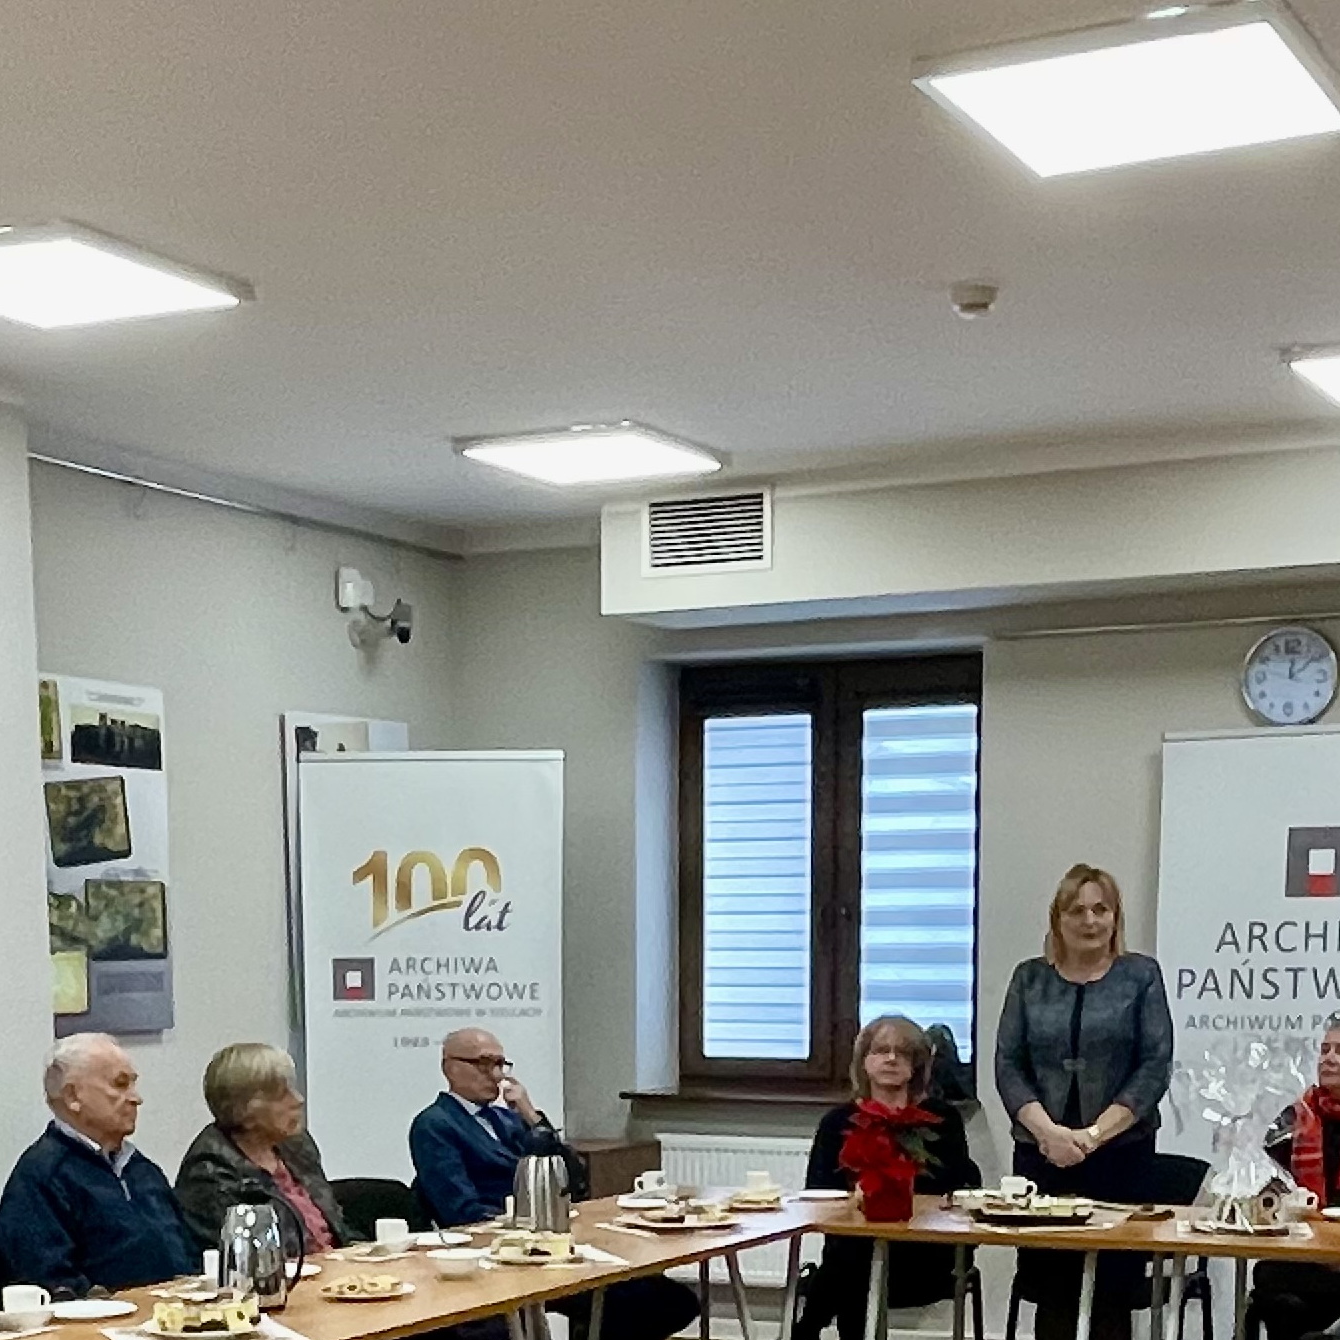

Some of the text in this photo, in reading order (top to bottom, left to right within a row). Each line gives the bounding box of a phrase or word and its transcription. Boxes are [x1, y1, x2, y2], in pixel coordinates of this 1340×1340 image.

[352, 846, 502, 929] 100
[388, 956, 500, 976] ARCHIWA
[387, 976, 541, 1001] PAŃSTWOWE
[1184, 1013, 1304, 1032] ARCHIWUM
